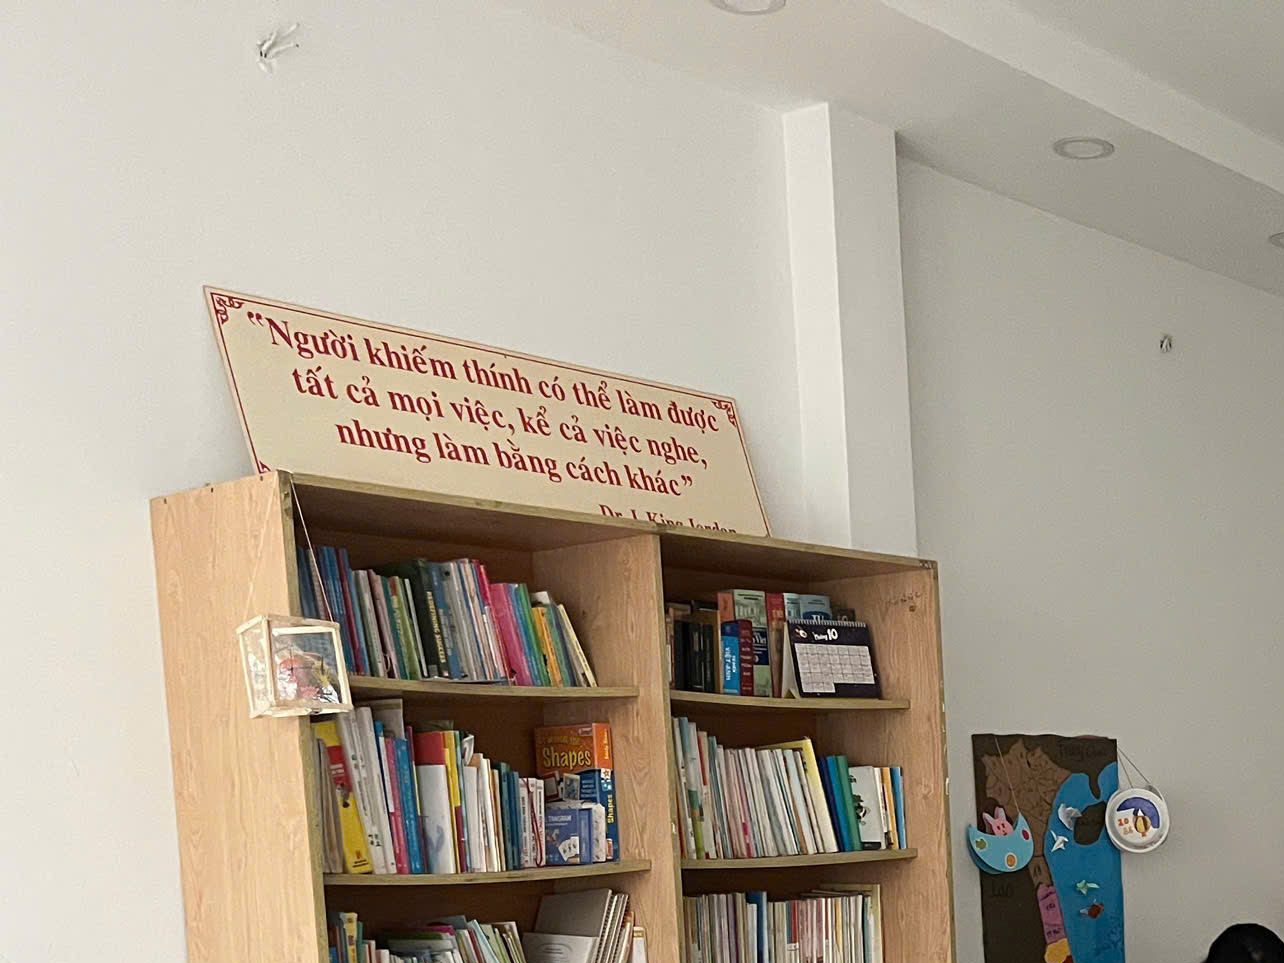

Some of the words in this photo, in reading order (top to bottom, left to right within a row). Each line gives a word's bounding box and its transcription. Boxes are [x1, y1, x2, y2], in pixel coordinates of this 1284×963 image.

[292, 366, 338, 400] tất
[346, 376, 380, 407] cả
[387, 391, 444, 421] mọi
[449, 397, 515, 435] việc,
[517, 406, 552, 437] kể
[559, 415, 587, 443] cả
[593, 424, 642, 455] việc
[646, 436, 707, 470] nghe,
[363, 338, 458, 380] khiếm
[462, 359, 533, 395] thính
[538, 376, 566, 402] có
[572, 381, 612, 410] thể
[616, 389, 663, 421] làm
[667, 400, 719, 434] được
[335, 418, 431, 463] nhưng
[432, 432, 490, 465] làm
[492, 439, 562, 483] bằng
[566, 457, 622, 486] cách
[624, 464, 693, 496] khác”
[827, 628, 839, 641] 10
[543, 747, 591, 770] Shapes
